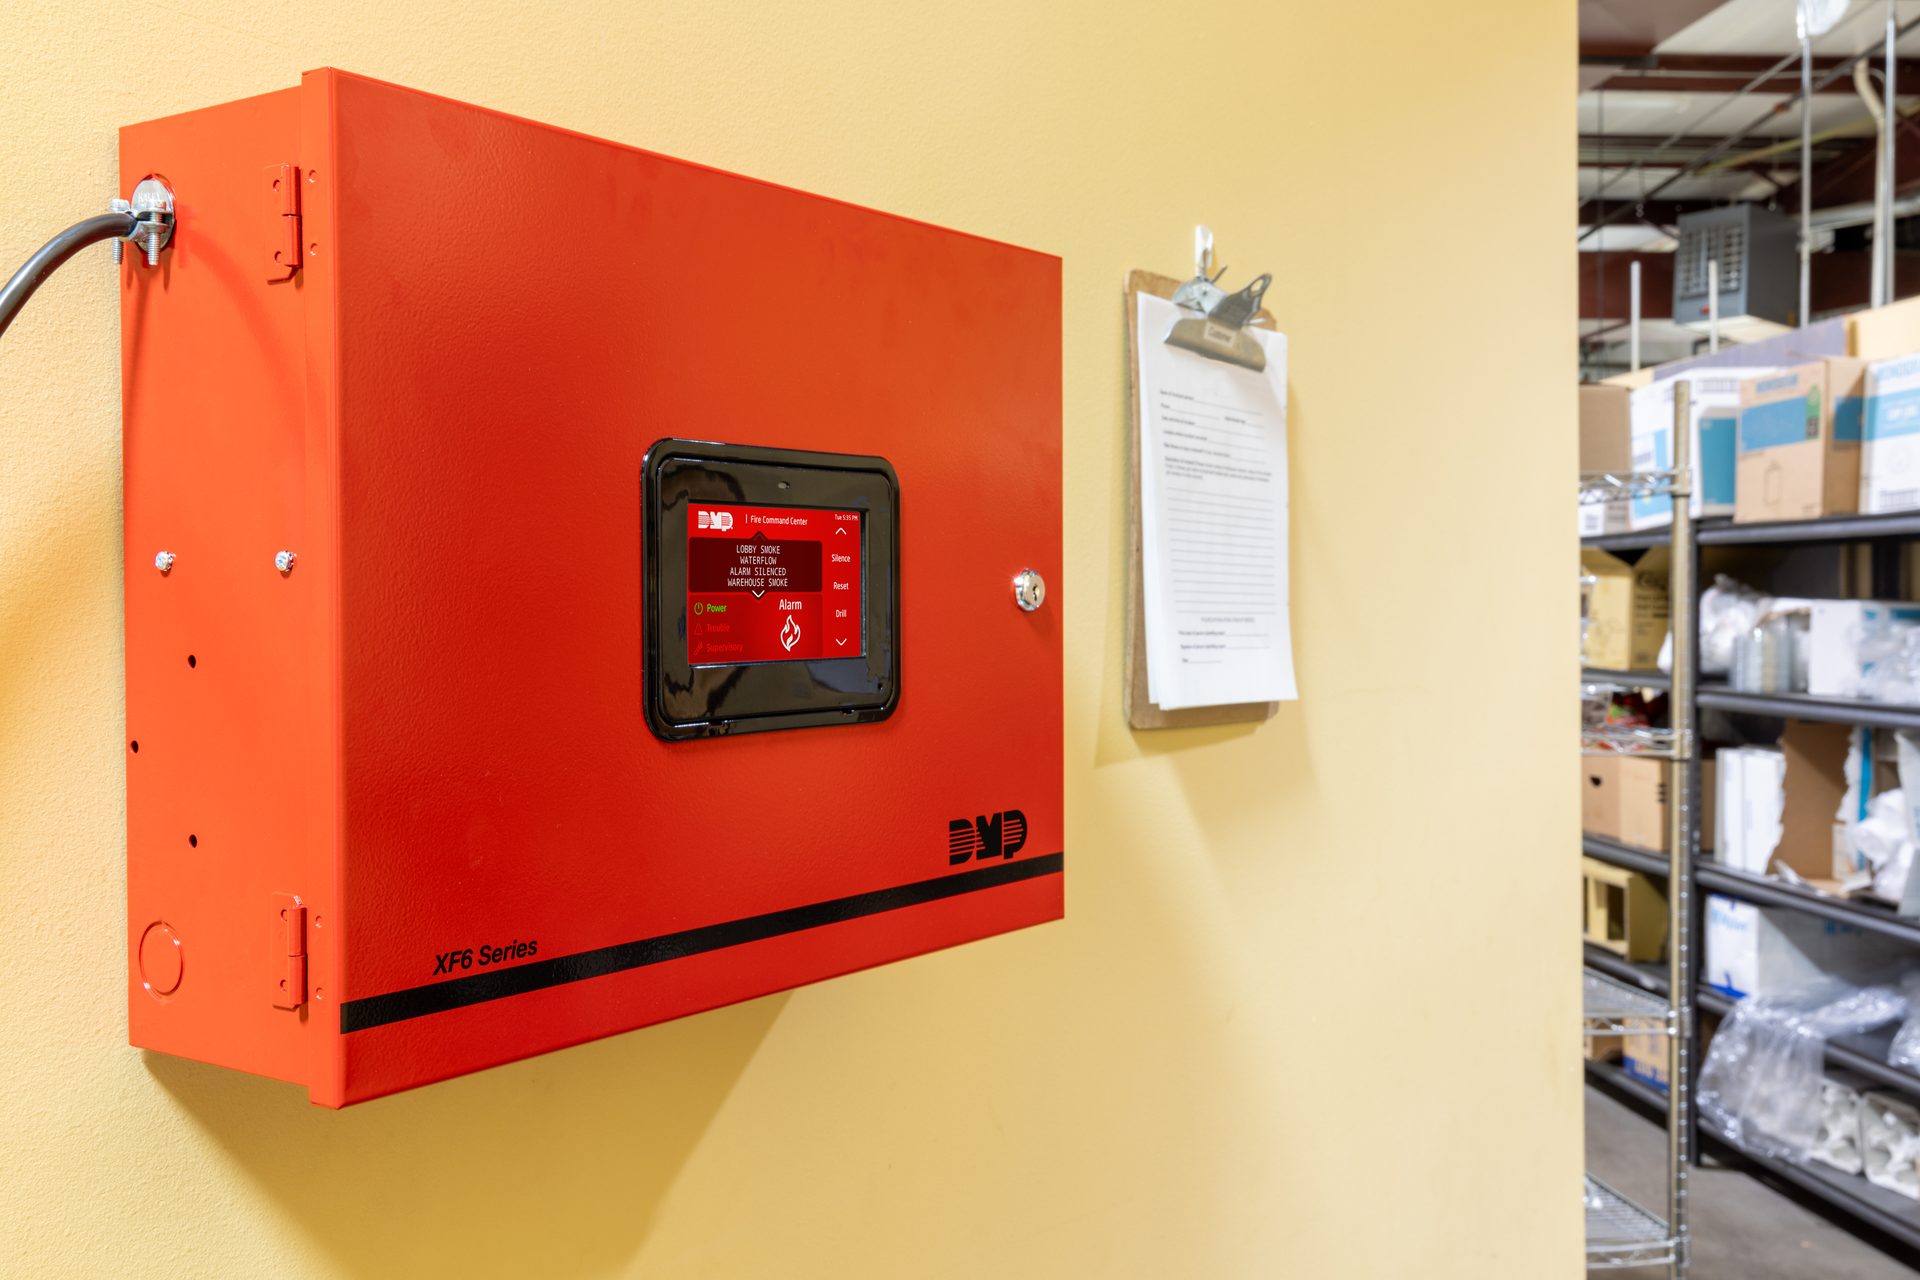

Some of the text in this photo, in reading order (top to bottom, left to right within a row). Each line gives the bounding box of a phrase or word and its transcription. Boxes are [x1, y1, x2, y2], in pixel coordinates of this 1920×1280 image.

[750, 515, 808, 526] Fire Command Center
[736, 545, 781, 555] LOBBY SMOKE
[739, 556, 777, 565] WATERFLOW
[831, 553, 851, 563] Silence
[729, 567, 787, 576] ALARM SILENCED
[727, 578, 788, 587] WAREHOUSE SMOKE
[833, 581, 849, 591] Reset
[706, 603, 727, 613] Power
[779, 599, 802, 610] Alarm
[835, 609, 847, 618] Drill
[706, 623, 730, 633] Trouble
[948, 809, 1028, 866] DMP
[432, 939, 538, 976] XF6 Series
